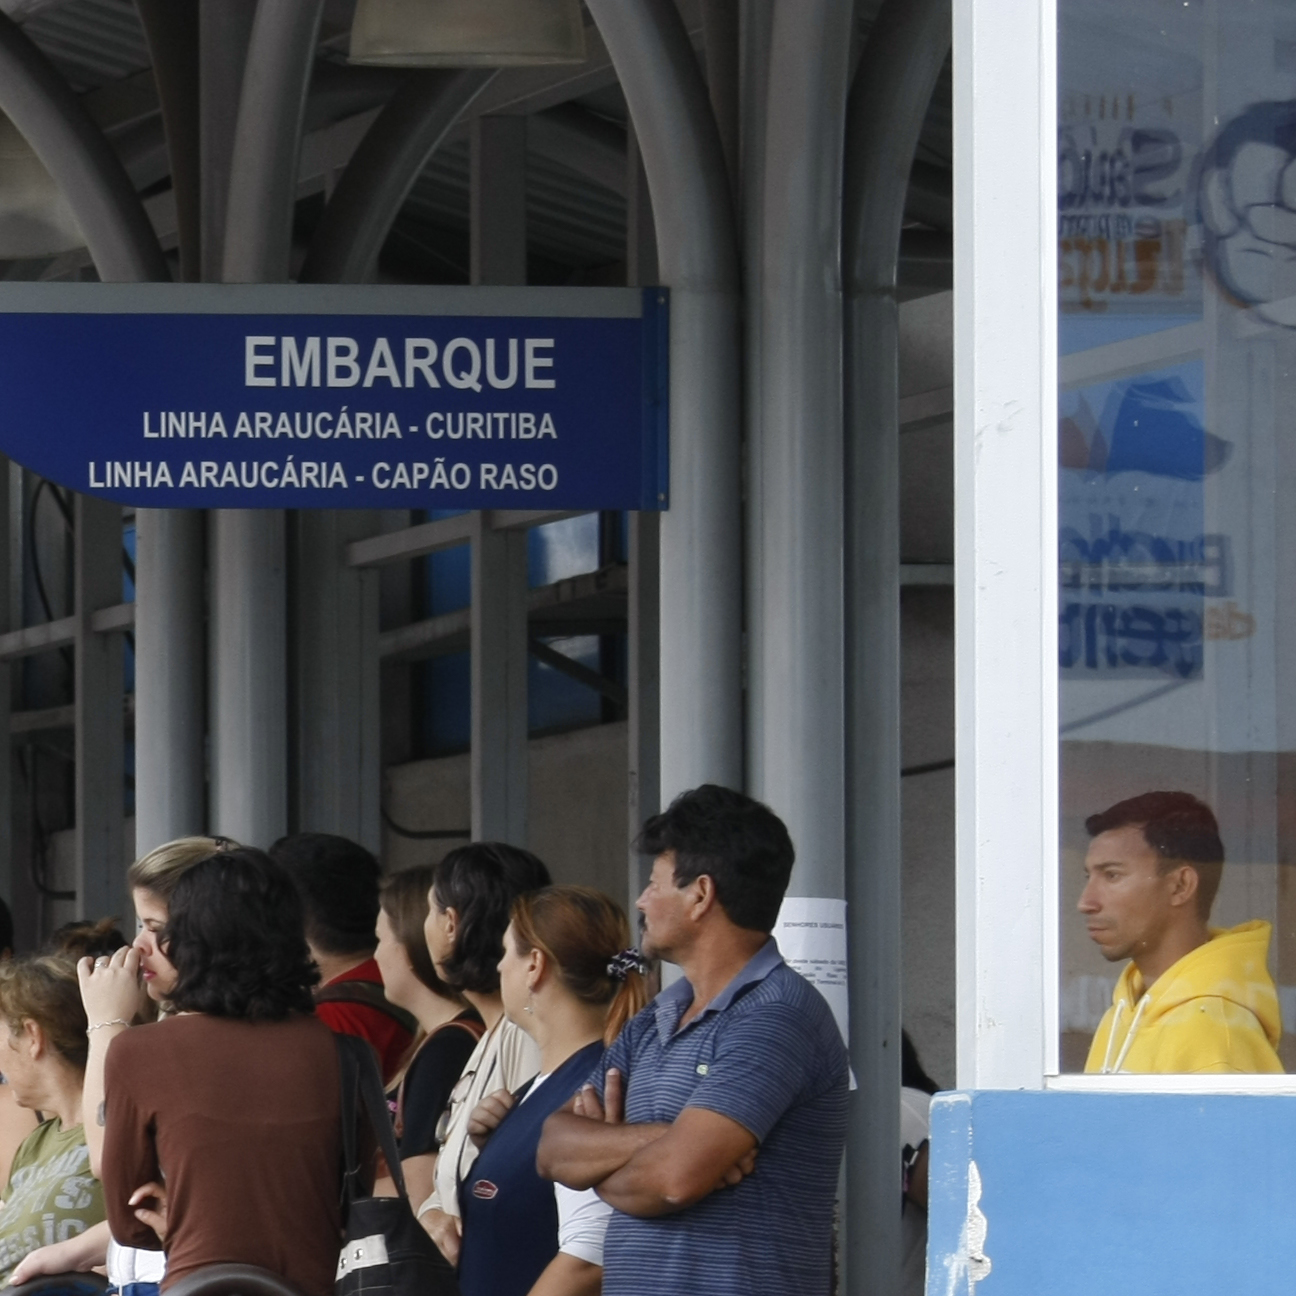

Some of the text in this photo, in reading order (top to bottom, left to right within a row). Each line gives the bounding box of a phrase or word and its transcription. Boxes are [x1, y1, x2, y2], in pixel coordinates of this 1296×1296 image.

[245, 335, 556, 393] EMBARQUE
[143, 411, 228, 439] LINHA
[233, 405, 403, 439] ARAUCÁRIA
[425, 412, 558, 440] CURITIBA
[88, 461, 174, 488] LINHA
[178, 454, 349, 489] ARAUCÁRIA
[371, 457, 471, 490] CAPÃO
[480, 463, 558, 491] RASO
